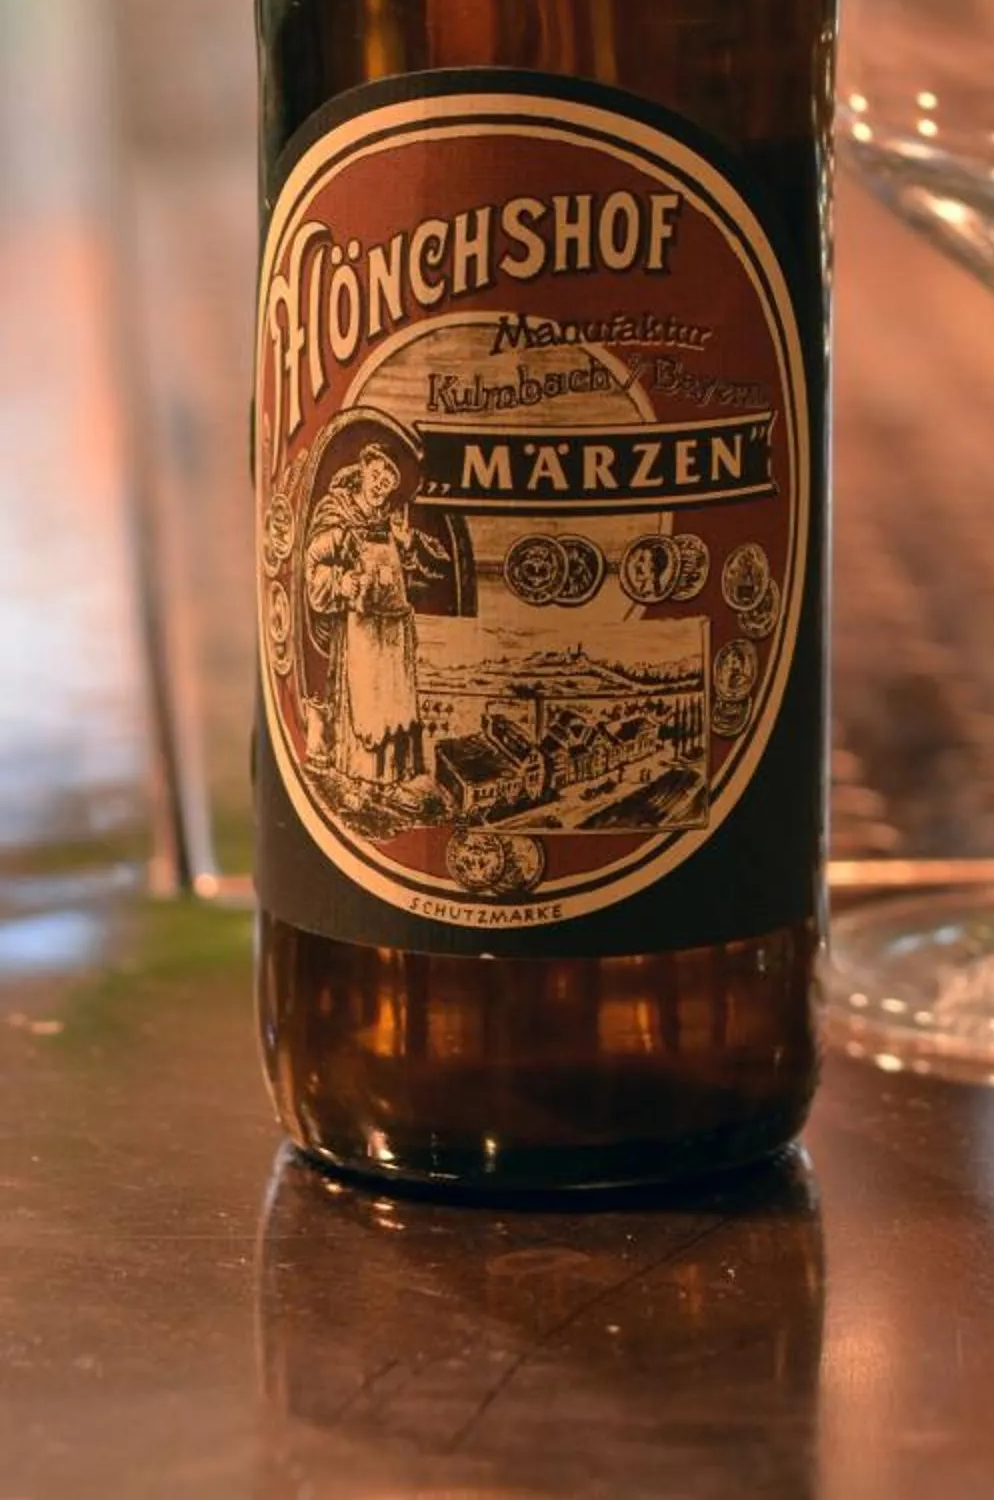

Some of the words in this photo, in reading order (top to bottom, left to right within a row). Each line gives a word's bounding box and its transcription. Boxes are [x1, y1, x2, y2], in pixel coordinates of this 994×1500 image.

[266, 190, 682, 478] MÖNCHSHOF
[489, 314, 713, 355] Manufaktur
[427, 356, 612, 414] Kulmbach
[409, 897, 562, 924] SCHUTZMARKE
